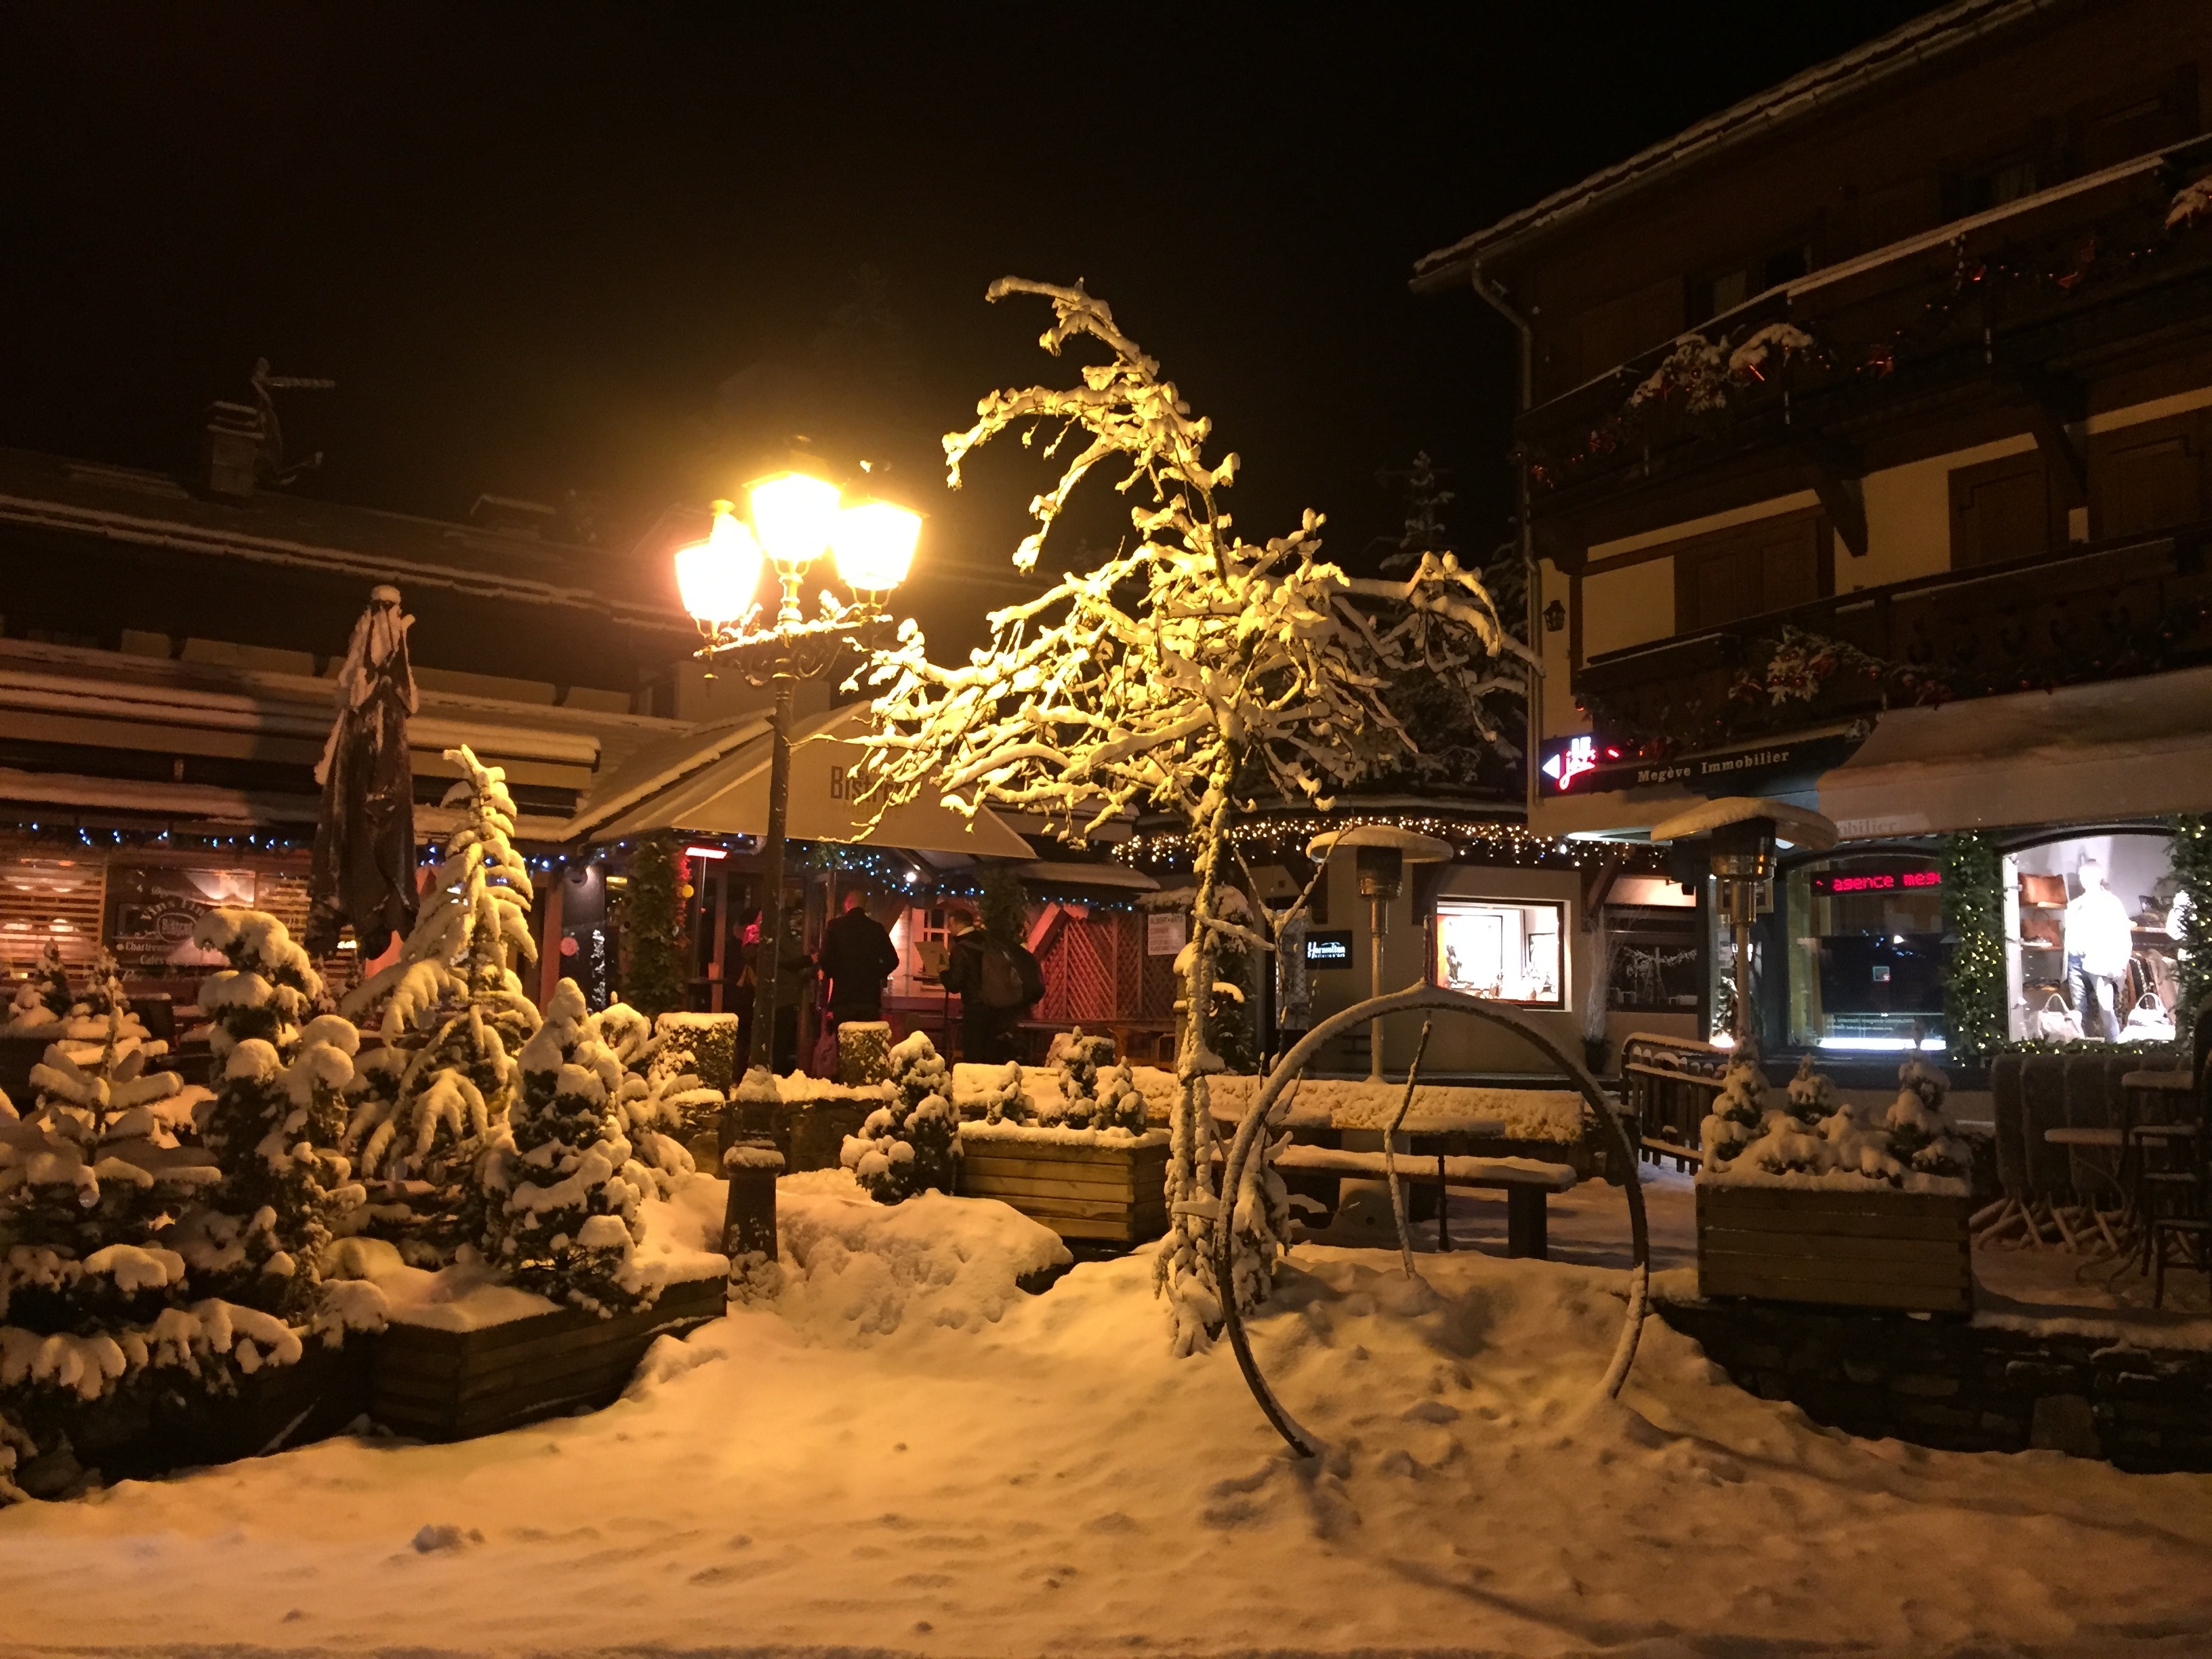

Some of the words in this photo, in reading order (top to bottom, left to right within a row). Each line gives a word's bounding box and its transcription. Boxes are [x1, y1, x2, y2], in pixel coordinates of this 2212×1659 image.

[1637, 766, 1691, 782] Megève
[1701, 751, 1790, 774] Immobilier
[1837, 817, 1899, 836] obilier
[1833, 875, 1894, 892] agence
